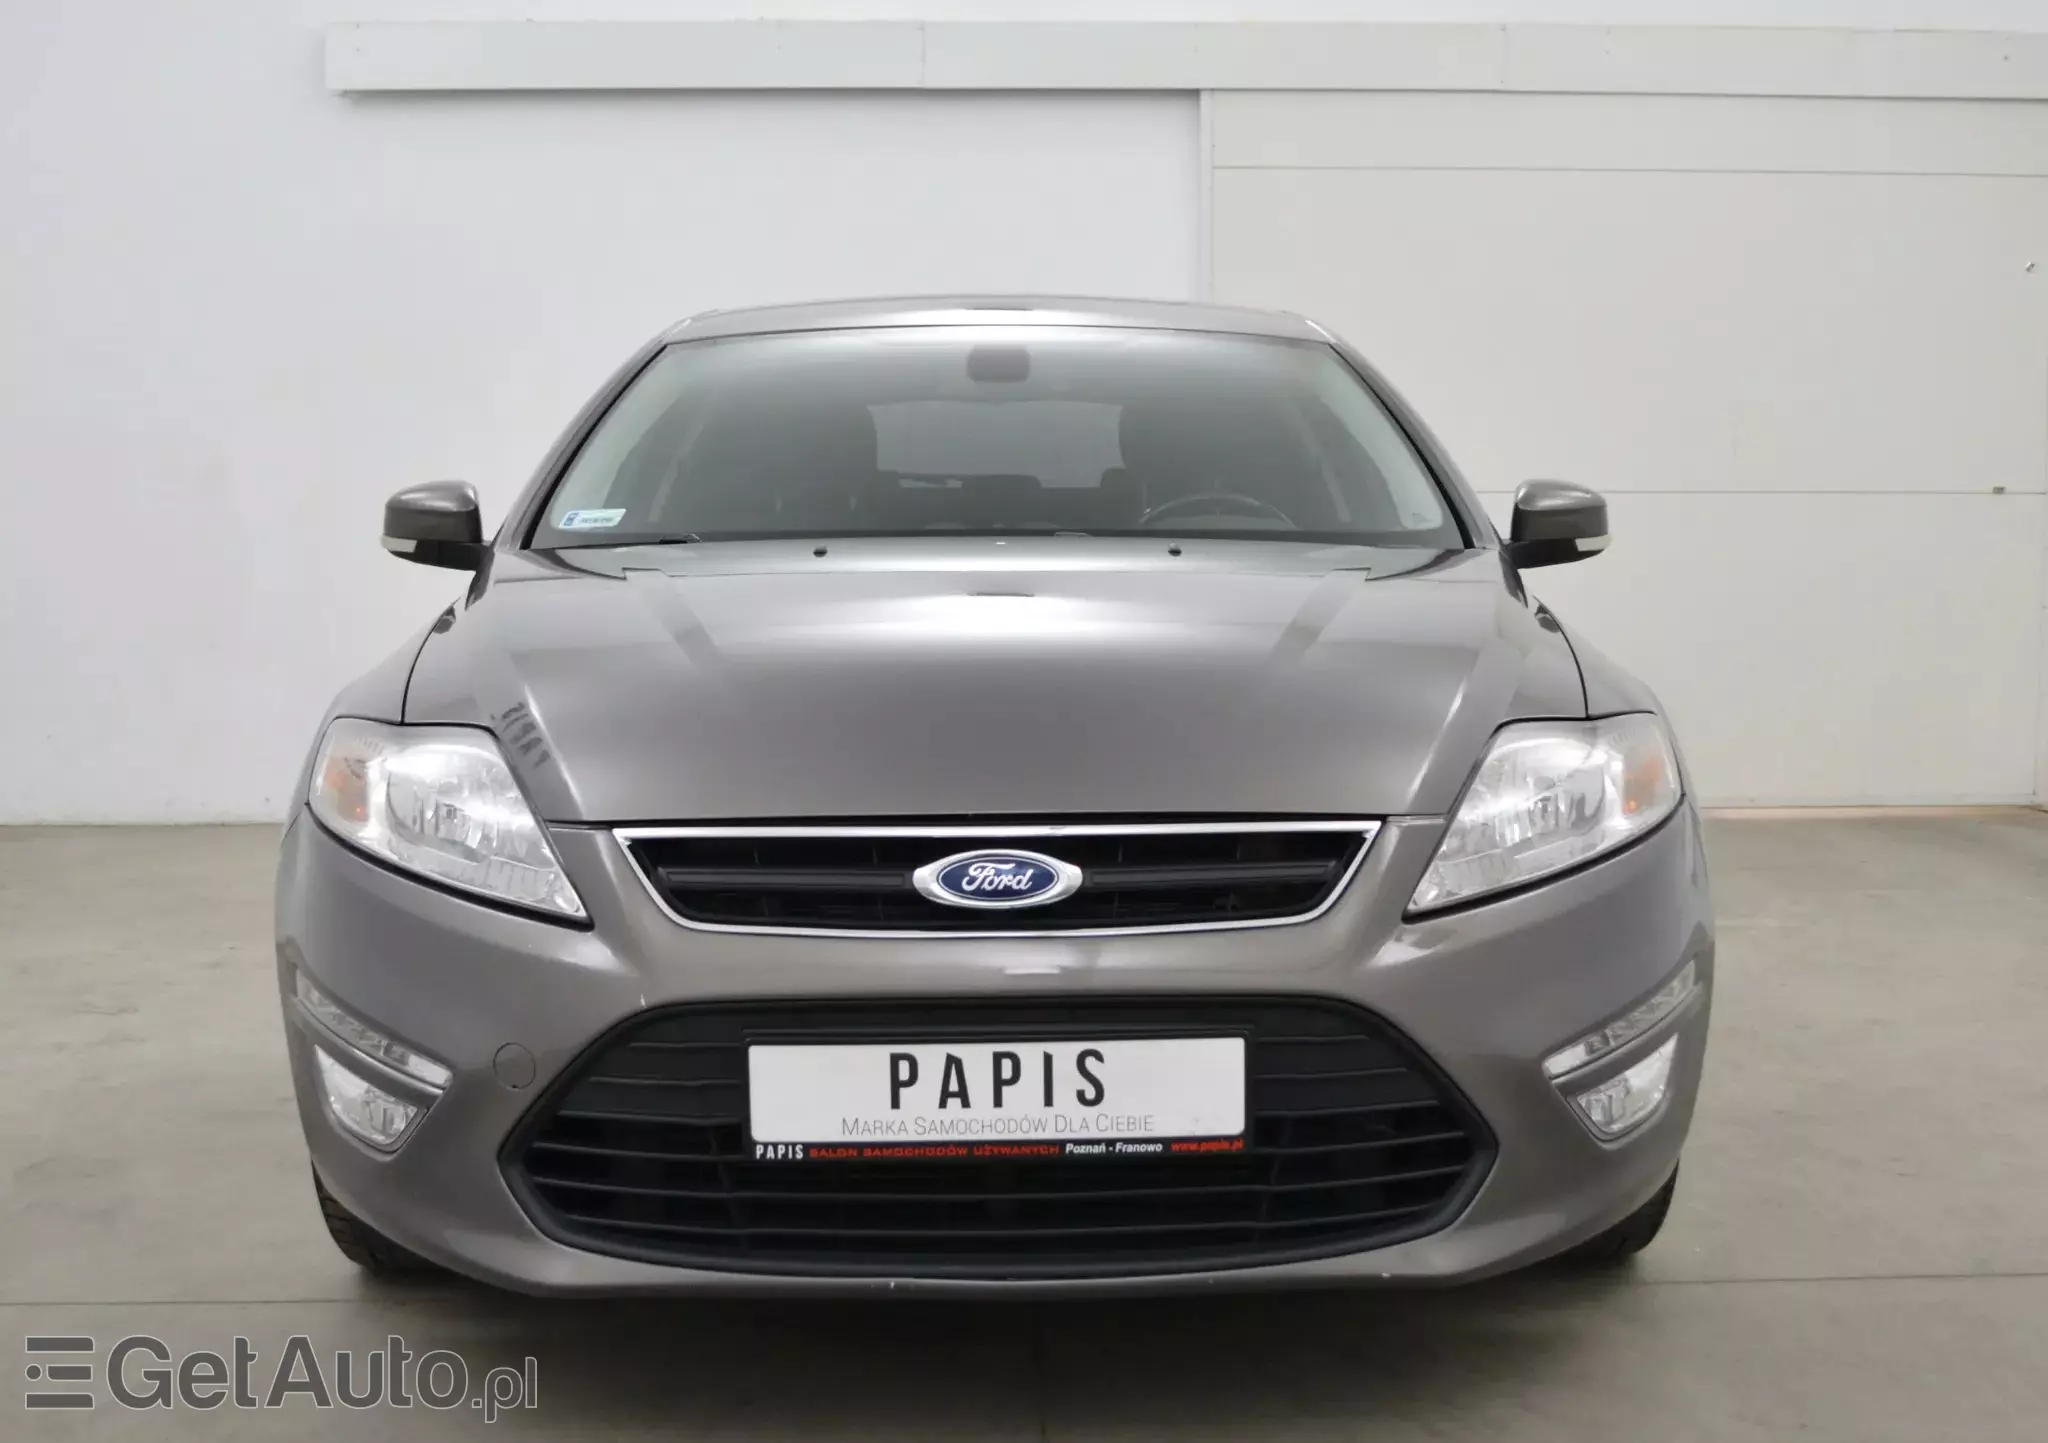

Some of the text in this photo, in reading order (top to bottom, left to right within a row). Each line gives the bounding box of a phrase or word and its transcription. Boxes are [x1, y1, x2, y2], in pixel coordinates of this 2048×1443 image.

[961, 862, 1034, 892] Ford
[889, 1048, 1105, 1110] PAPIS
[755, 1144, 804, 1159] PAPIS
[809, 1147, 858, 1158] SALON
[1065, 1142, 1106, 1154] Poznań
[1115, 1141, 1163, 1153] Franowo
[1171, 1138, 1244, 1153] www.papis.pl
